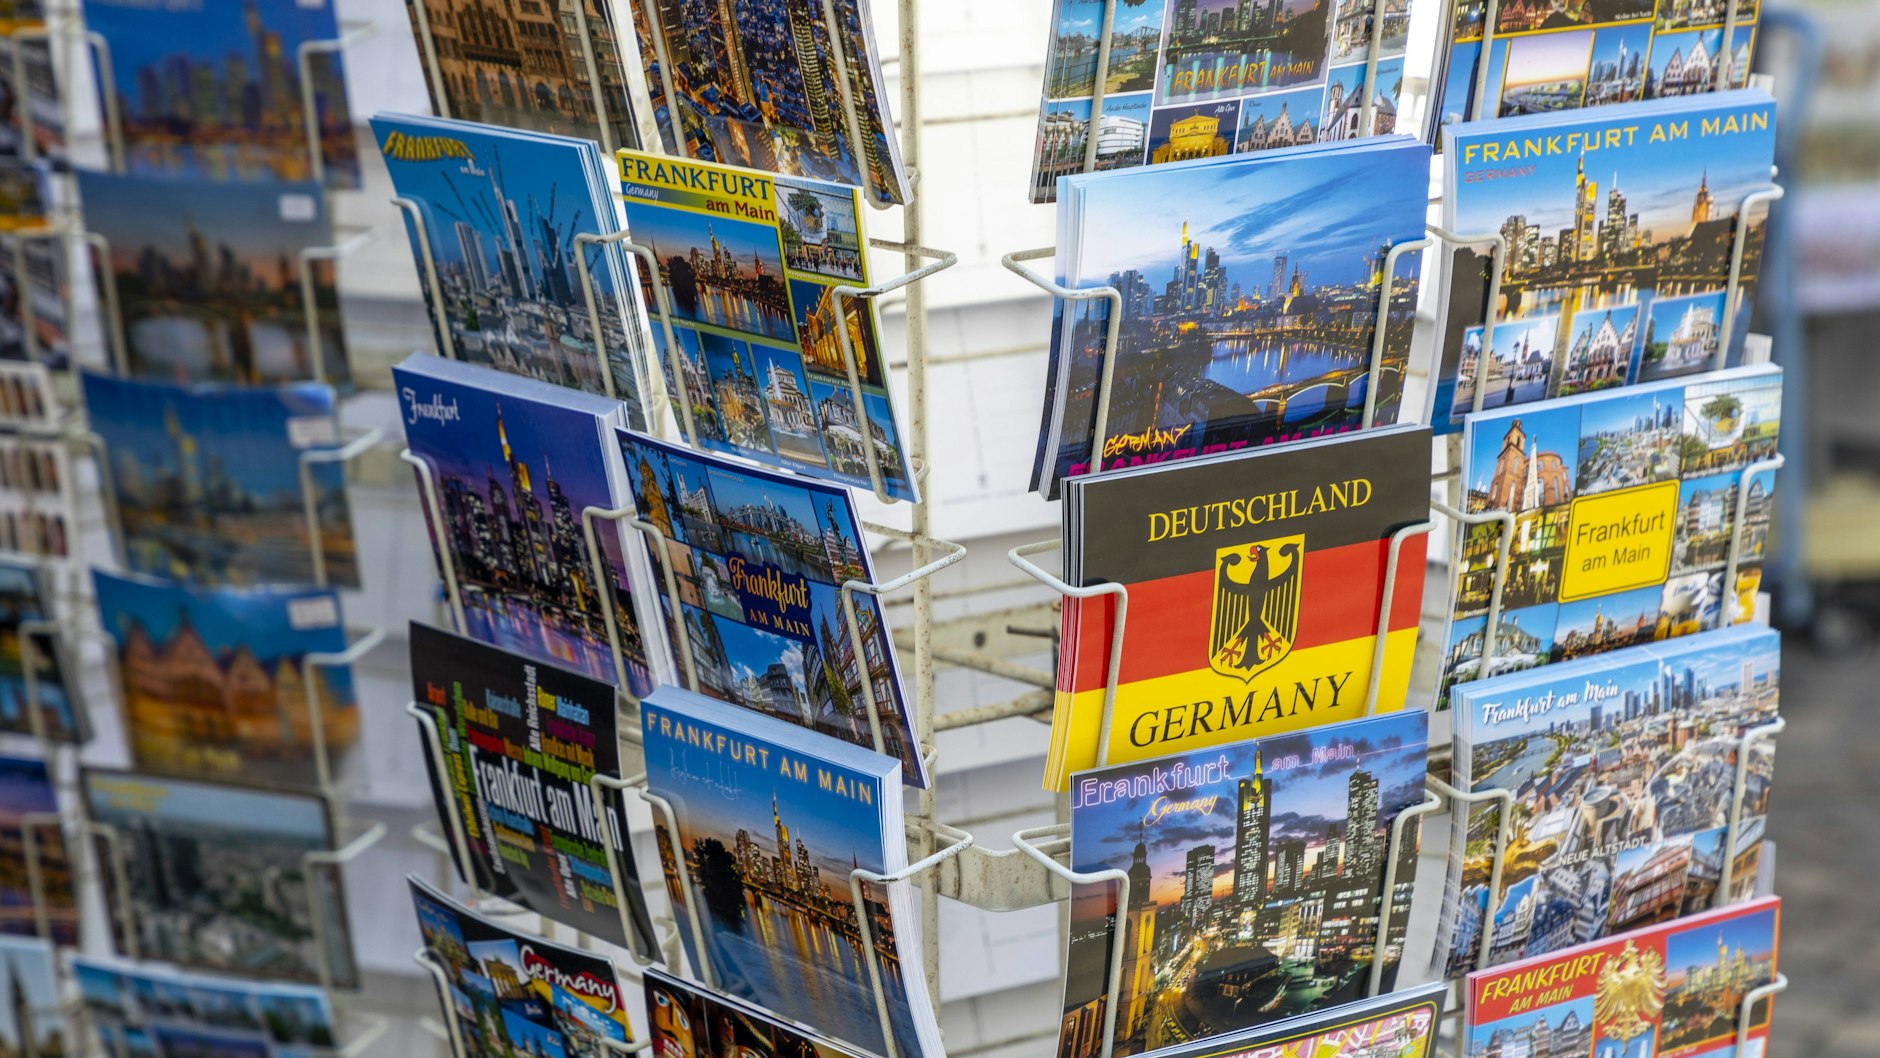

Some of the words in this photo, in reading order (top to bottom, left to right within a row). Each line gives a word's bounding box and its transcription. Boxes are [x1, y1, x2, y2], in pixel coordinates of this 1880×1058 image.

[1174, 60, 1267, 94] FRANKFURT
[1269, 64, 1286, 79] AM
[1287, 60, 1314, 78] MAIN
[383, 130, 476, 162] FRANKFURT
[1464, 126, 1640, 165] FRANKFURT
[1649, 120, 1688, 143] AM
[1700, 111, 1769, 136] MAIN
[621, 157, 771, 200] FRANKFURT
[1464, 164, 1536, 184] GERMANY
[625, 183, 659, 206] Germany
[706, 198, 730, 214] am
[735, 201, 776, 222] Main
[402, 386, 460, 427] Frankfurt
[1103, 423, 1191, 458] GERMANY
[1148, 478, 1372, 544] DEUTSCHLAND
[1576, 510, 1665, 547] Frankfurt
[1581, 554, 1607, 572] am
[1613, 545, 1651, 565] Main
[728, 556, 810, 614] Frankfurt
[749, 608, 768, 624] AM
[773, 615, 812, 638] MAIN
[1130, 670, 1354, 748] GERMANY
[1482, 692, 1556, 726] Frankfurt
[1557, 693, 1580, 709] am
[1583, 679, 1621, 703] Main
[646, 712, 770, 769] FRANKFURT
[780, 757, 808, 784] AM
[818, 769, 872, 806] MAIN
[1078, 754, 1231, 808] Frankfurt
[1271, 754, 1300, 771] am
[1311, 742, 1356, 765] Main
[469, 743, 548, 824] Frankfurt
[546, 784, 577, 836] am
[573, 780, 624, 854] Man
[1143, 794, 1219, 828] Germany
[1559, 848, 1589, 865] NEUE
[1591, 837, 1647, 858] ALTSTADT
[519, 945, 617, 1014] Germany
[1479, 950, 1608, 1005] FRANKFURT
[1508, 996, 1534, 1015] AM
[1535, 984, 1574, 1008] MAIN
